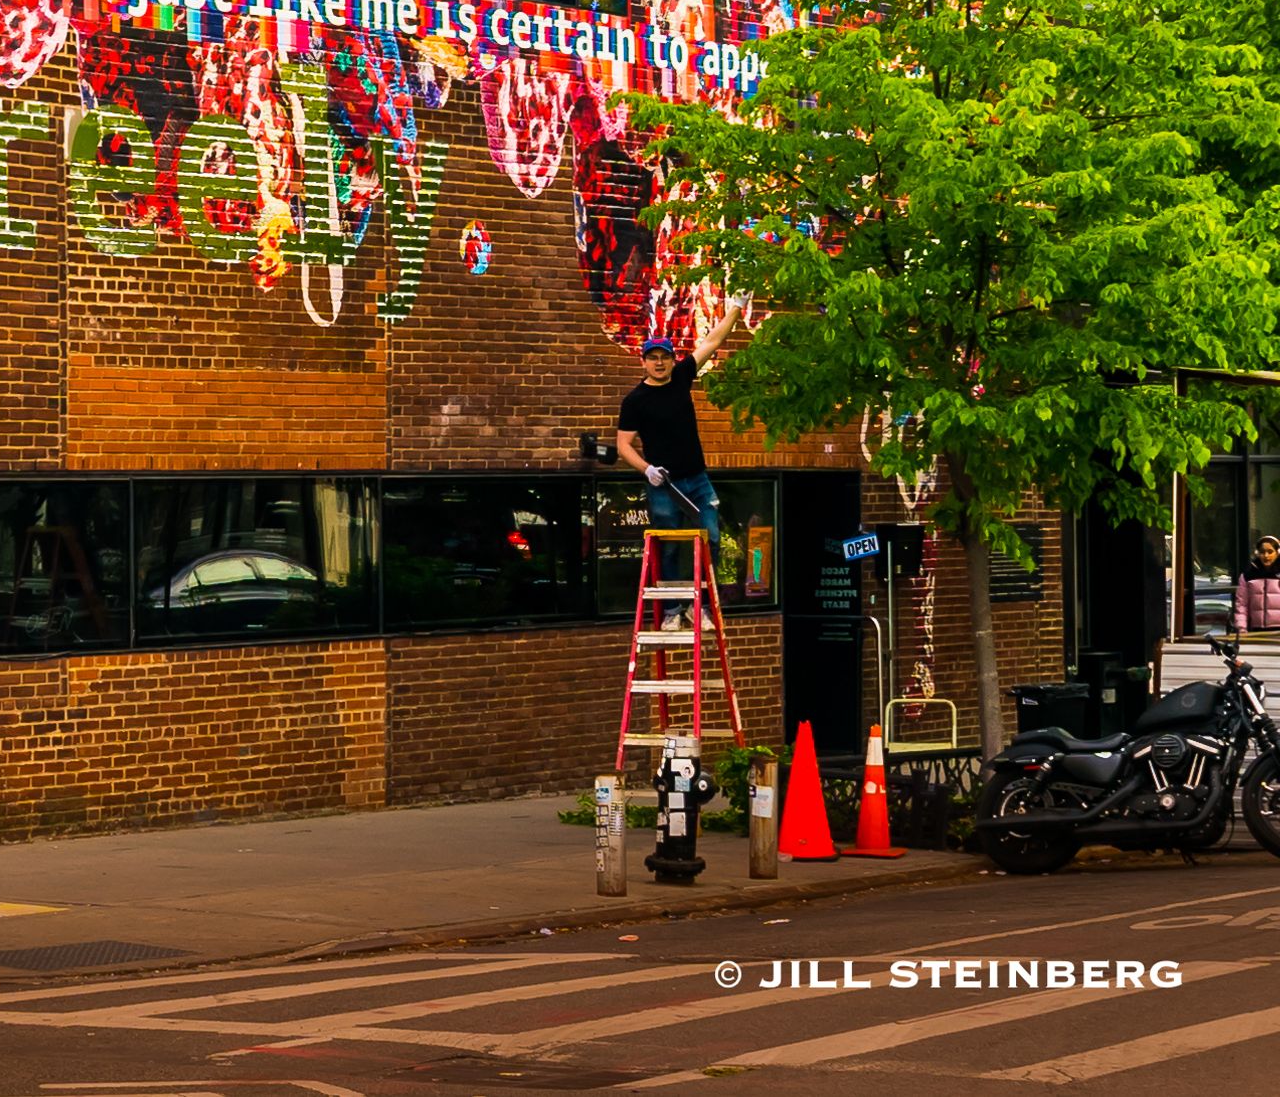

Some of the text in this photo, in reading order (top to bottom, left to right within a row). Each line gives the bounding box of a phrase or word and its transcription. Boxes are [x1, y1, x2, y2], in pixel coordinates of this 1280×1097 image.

[490, 6, 636, 66] certain
[648, 23, 688, 72] to
[847, 537, 877, 557] OPEN
